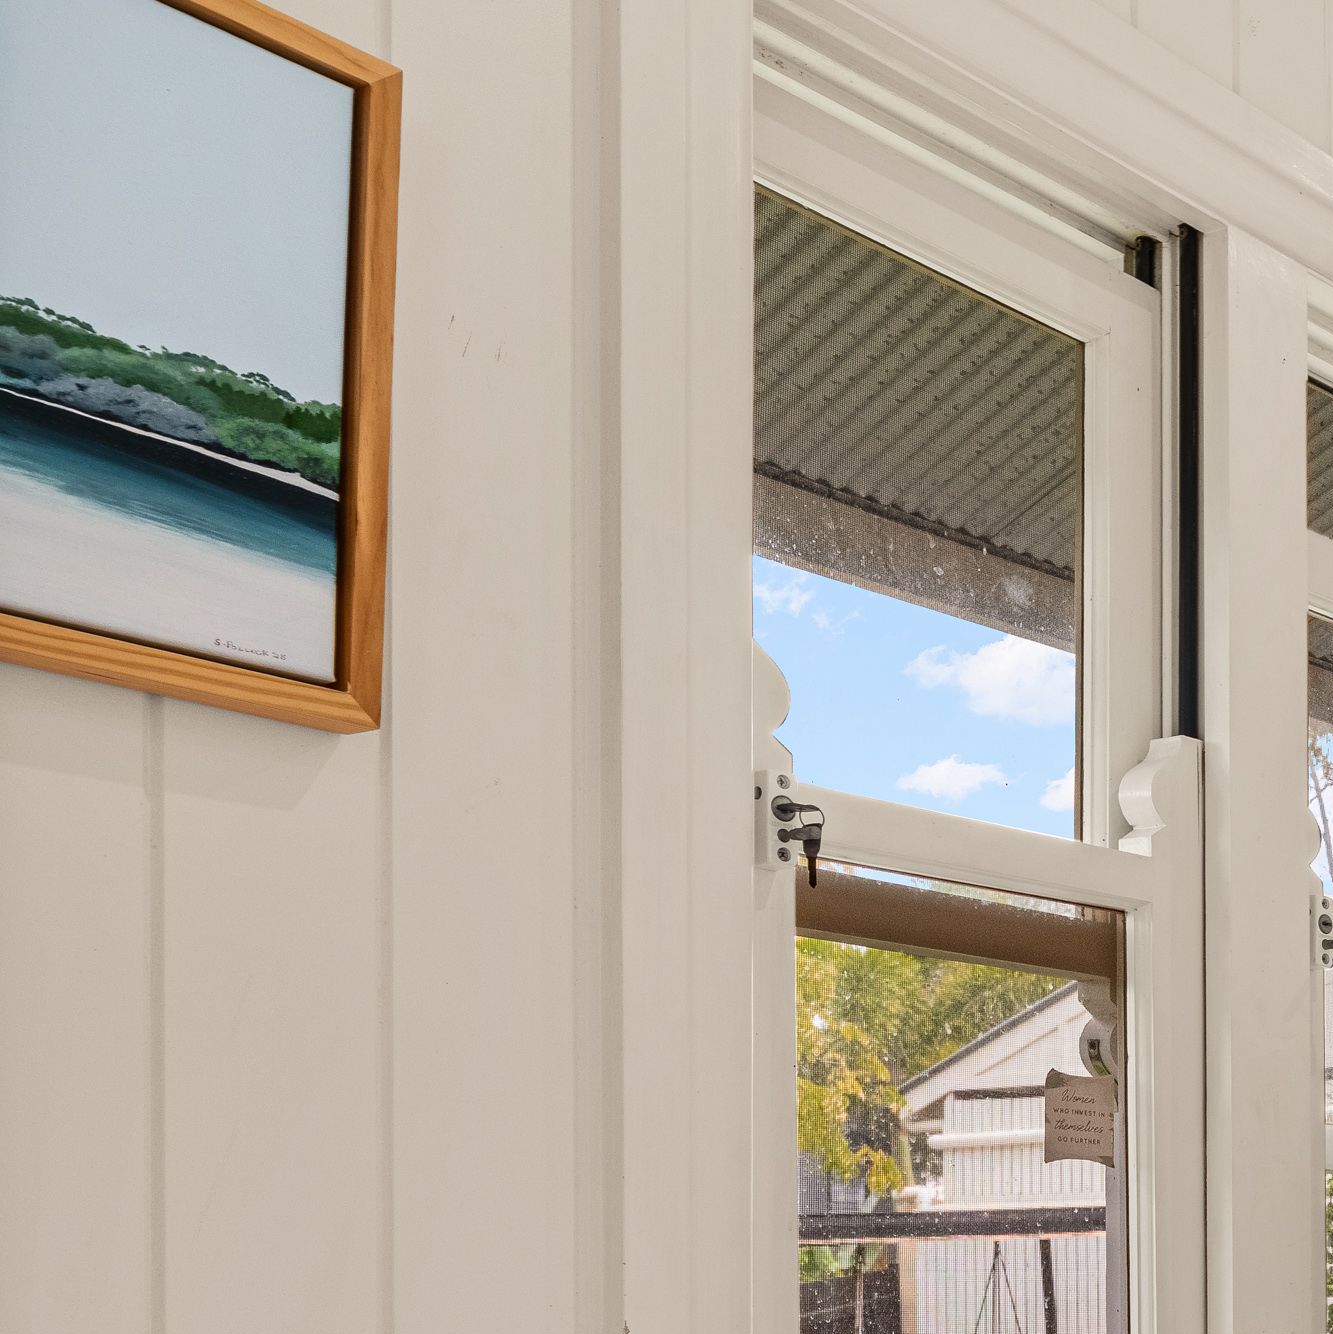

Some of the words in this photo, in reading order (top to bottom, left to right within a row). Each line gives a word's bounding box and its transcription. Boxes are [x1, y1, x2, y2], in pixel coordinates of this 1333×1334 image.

[1061, 1088, 1097, 1104] Women
[1071, 1109, 1097, 1117] INVEST
[1055, 1118, 1104, 1134] themselves
[1070, 1137, 1101, 1145] FURTHER
